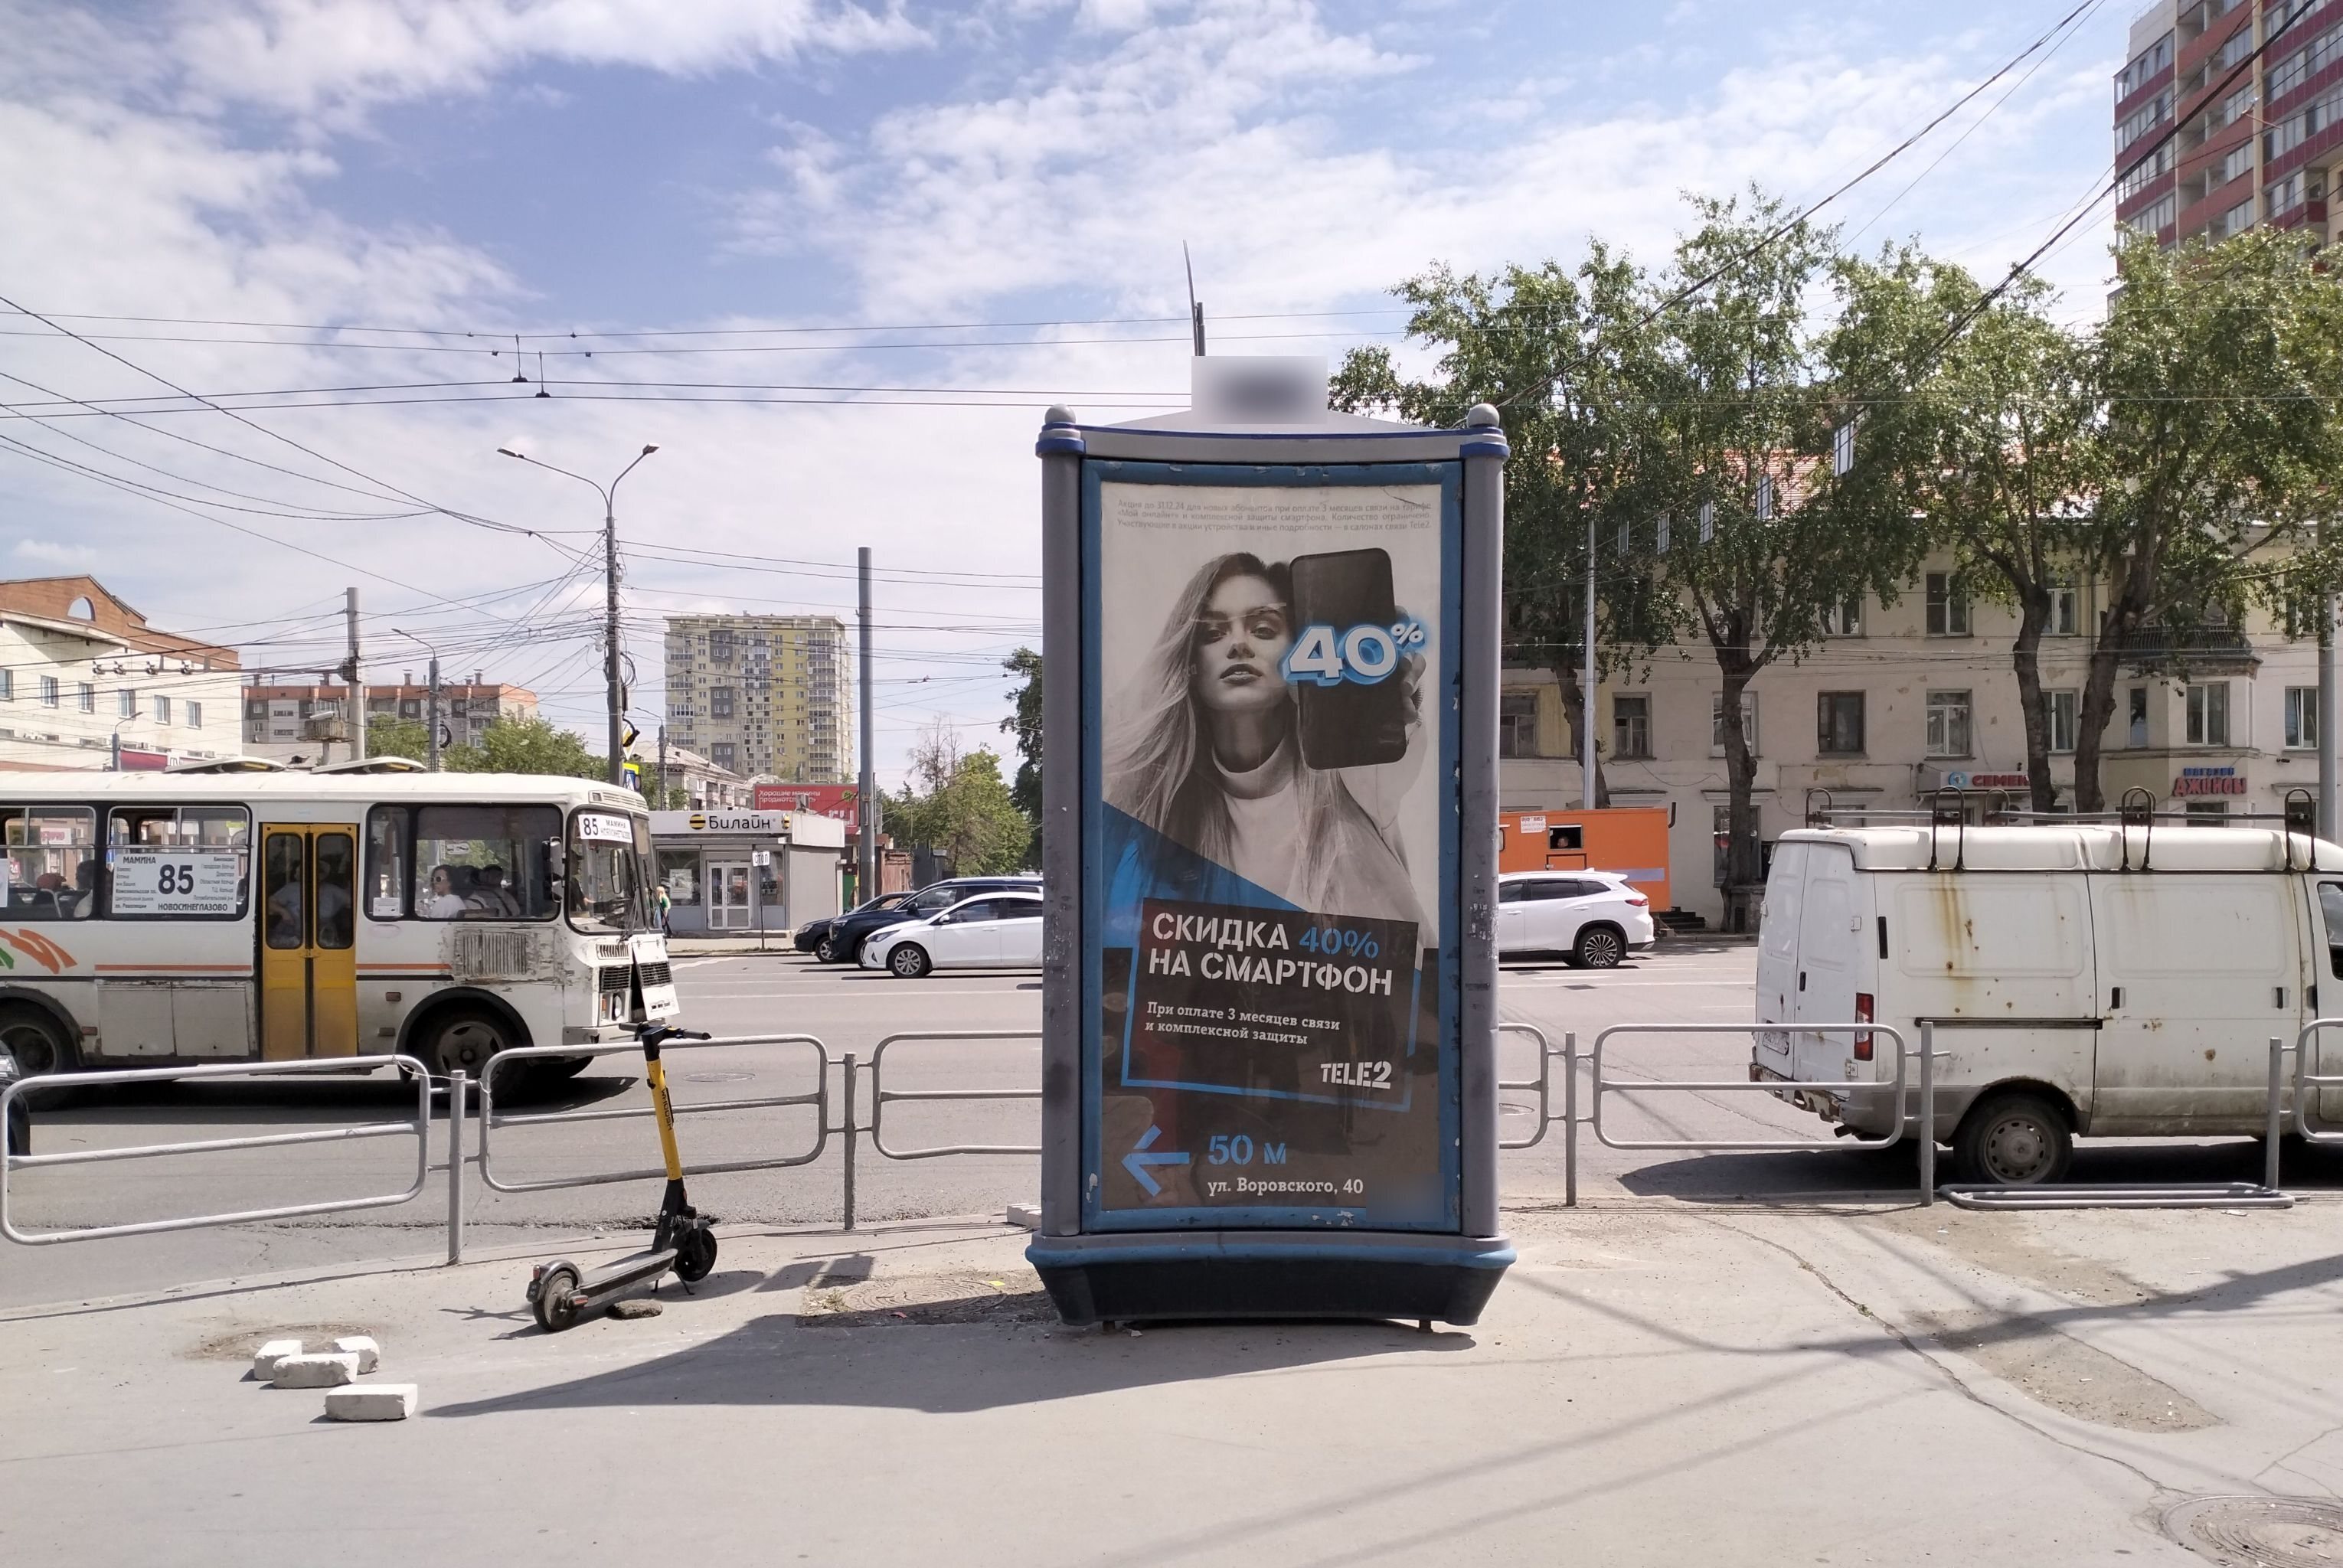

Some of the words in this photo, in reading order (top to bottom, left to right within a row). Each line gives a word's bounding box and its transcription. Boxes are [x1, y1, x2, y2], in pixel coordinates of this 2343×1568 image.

[1118, 499, 1142, 509] Акция
[1144, 501, 1155, 510] до
[1275, 505, 1290, 514] при
[1292, 505, 1320, 513] оплате
[1322, 504, 1327, 512] 3
[1329, 505, 1363, 513] месяцев
[1191, 512, 1243, 521] комплексной
[1117, 518, 1172, 528] Участвующие
[1205, 524, 1249, 532] устройства
[1279, 524, 1332, 533] подробности
[1283, 622, 1425, 686] 40%
[583, 818, 599, 836] 85
[709, 815, 770, 829] Билайн
[158, 864, 194, 894] 85
[1153, 913, 1289, 952] СКИДКА
[1299, 926, 1379, 959] 40%
[1149, 948, 1191, 977] НА
[1201, 952, 1392, 995] СМАРТФОН
[1147, 1001, 1174, 1018] При
[1177, 1006, 1224, 1020] оплате
[1227, 1008, 1236, 1020] 3
[1239, 1011, 1297, 1027] месяцев
[1302, 1018, 1340, 1031] связи
[1145, 1021, 1153, 1031] и
[1158, 1023, 1249, 1039] комплексной
[1253, 1030, 1308, 1044] защиты
[1320, 1061, 1392, 1089] TELE2
[662, 1088, 672, 1131] WHOOSH
[1208, 1135, 1253, 1165] 50
[1264, 1142, 1286, 1164] м
[1207, 1181, 1231, 1197] ул.
[1237, 1178, 1338, 1196] Воровского,
[1343, 1179, 1364, 1194] 40
